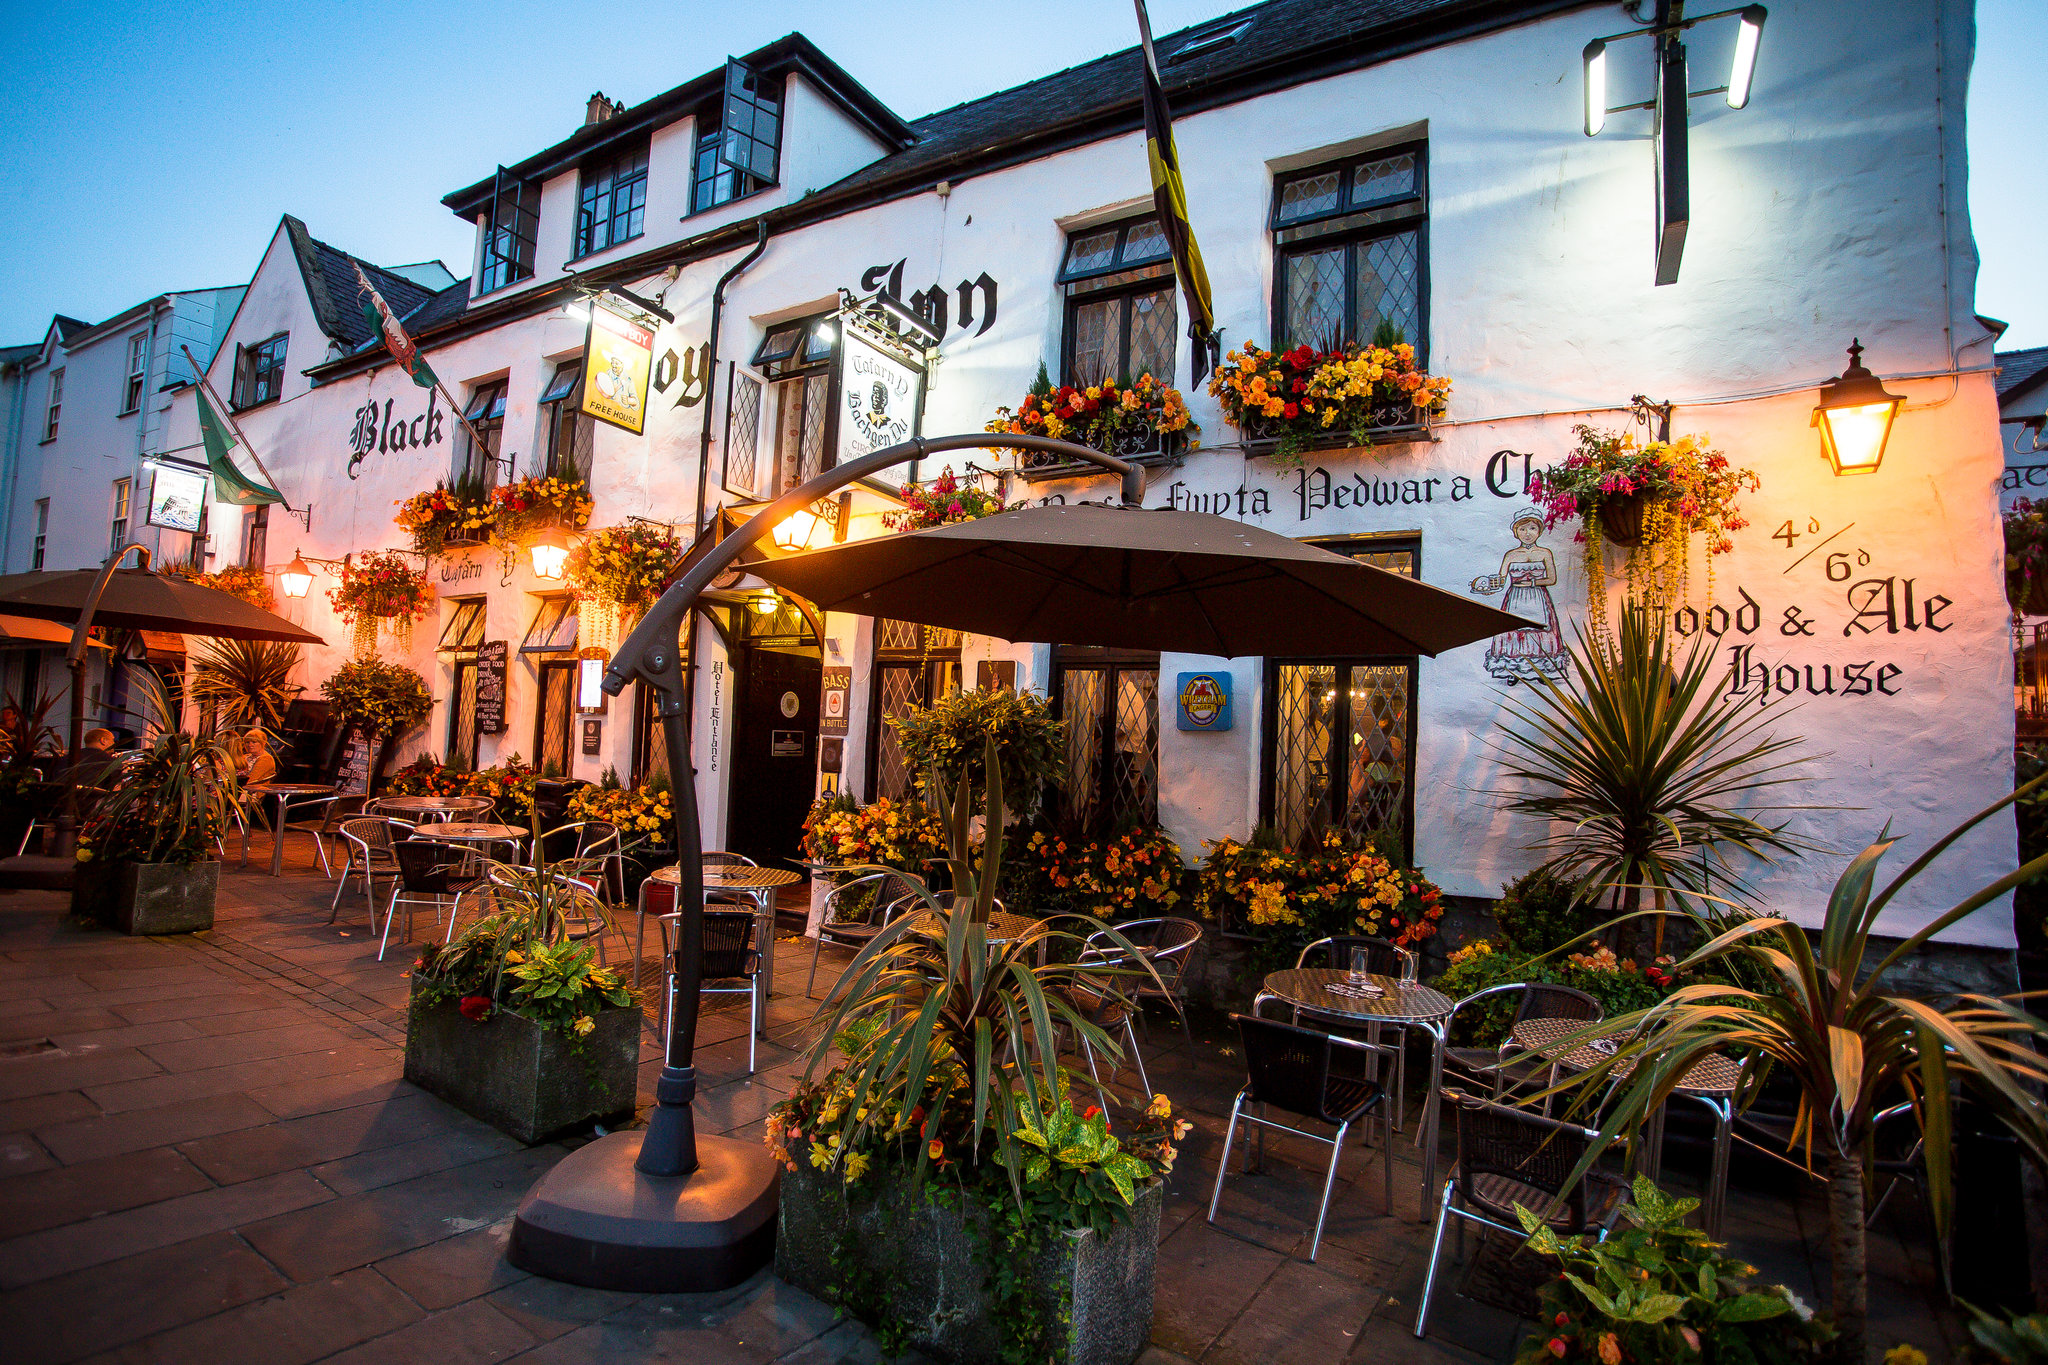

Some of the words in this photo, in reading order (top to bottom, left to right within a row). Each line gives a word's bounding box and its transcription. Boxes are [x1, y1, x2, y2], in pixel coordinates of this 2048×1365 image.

[347, 386, 444, 480] Black
[653, 341, 710, 411] oy
[861, 257, 998, 347] Inn
[852, 355, 895, 385] Tafarn
[589, 401, 611, 416] FREE
[613, 408, 637, 425] HOUSE
[847, 390, 891, 449] Bachgen
[890, 418, 908, 445] Du
[1293, 466, 1441, 521] Pedwar
[1450, 475, 1474, 501] a
[1484, 449, 1553, 498] Ch
[441, 561, 483, 587] Tafarn
[1634, 585, 1761, 638] ood
[1780, 605, 1816, 637] &
[1843, 576, 1953, 637] Ale
[711, 661, 724, 705] Hotel
[823, 674, 849, 690] BASS
[1723, 642, 1903, 707] House
[1180, 694, 1227, 707] WREXHAM
[1192, 703, 1212, 711] LAGER
[709, 707, 720, 771] Entrance
[826, 719, 848, 728] BOTTLE
